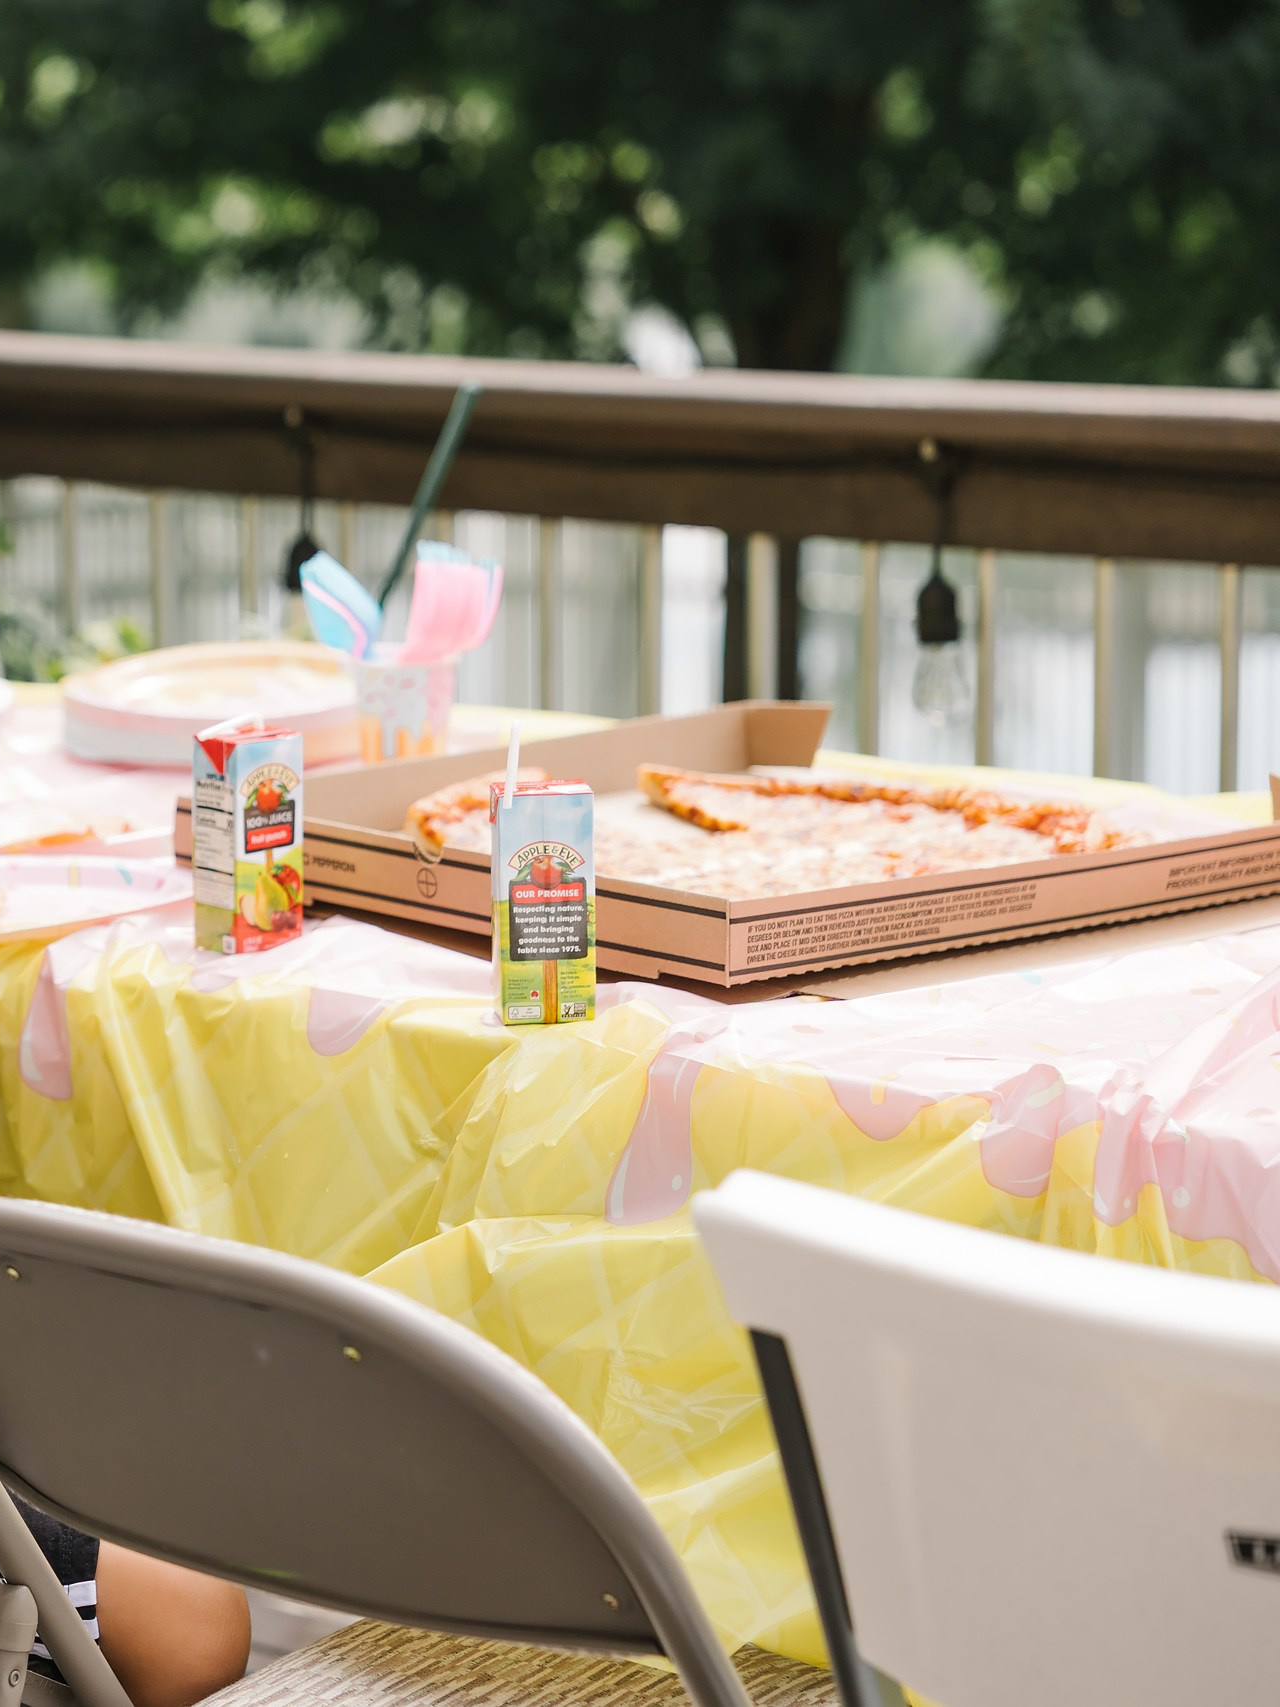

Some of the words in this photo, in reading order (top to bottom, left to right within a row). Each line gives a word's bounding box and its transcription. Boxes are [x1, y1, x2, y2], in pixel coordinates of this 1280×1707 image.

[518, 845, 550, 868] APPLE
[560, 846, 579, 866] EVE
[515, 890, 535, 899] OUR
[537, 889, 579, 898] PROMISE
[513, 905, 556, 914] Respecting
[515, 916, 548, 924] keeping
[556, 915, 582, 924] simple
[754, 924, 766, 932] YOU
[767, 922, 775, 930] DO
[789, 918, 803, 926] PLAN
[813, 915, 823, 923] EAT
[824, 913, 837, 921] THIS
[854, 908, 874, 916] WITHIN
[540, 926, 574, 934] bringing
[747, 933, 772, 943] DEGREES
[773, 931, 781, 939] OR
[782, 929, 801, 938] BELOW
[814, 924, 827, 933] THEN
[828, 920, 855, 930] REHEATED
[855, 918, 869, 926] JUST
[869, 916, 886, 924] PRIOR
[518, 936, 556, 945] goodness
[747, 945, 759, 953] BOX
[760, 943, 772, 951] AND
[773, 940, 790, 949] PLACE
[798, 937, 809, 945] MID
[811, 935, 826, 943] OVEN
[826, 931, 852, 941] DIRECTLY
[853, 929, 862, 937] ON
[874, 925, 889, 933] OVEN
[746, 954, 765, 965] (WHEN
[766, 952, 776, 960] THE
[777, 949, 797, 958] CHEESE
[798, 946, 817, 955] BEGINS
[826, 941, 849, 950] FURTHER
[850, 938, 870, 946] BROWN
[879, 933, 898, 942] BUBBLE
